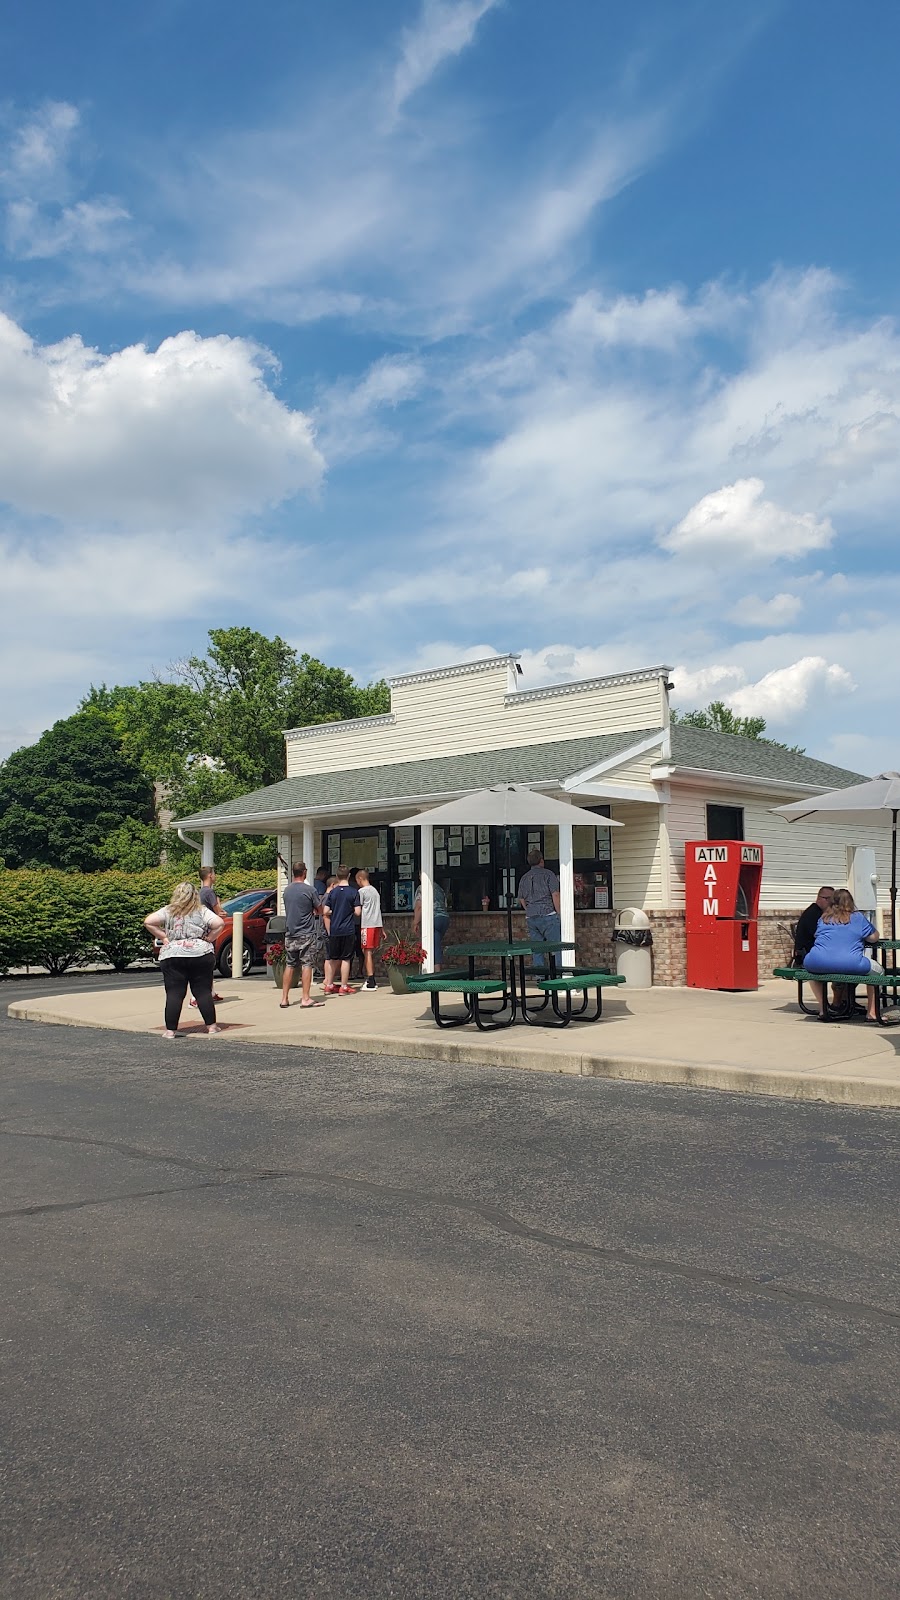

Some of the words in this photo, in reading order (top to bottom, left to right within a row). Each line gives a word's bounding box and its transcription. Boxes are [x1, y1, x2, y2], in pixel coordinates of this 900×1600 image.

[697, 848, 726, 861] ATM
[742, 848, 760, 862] ATM
[703, 864, 719, 916] ATM
